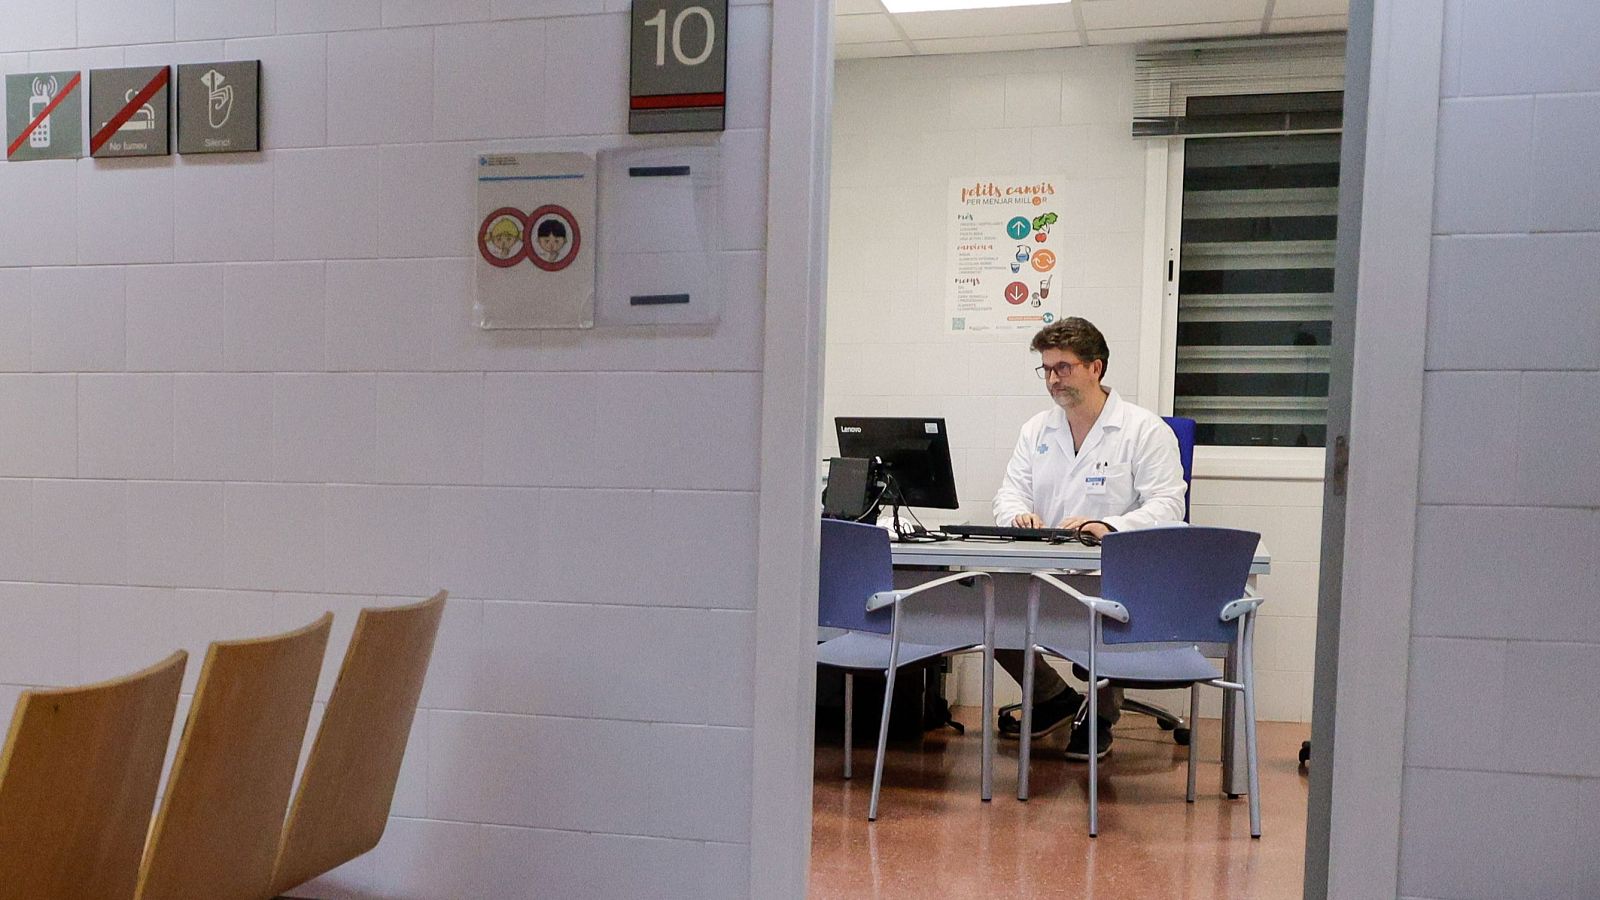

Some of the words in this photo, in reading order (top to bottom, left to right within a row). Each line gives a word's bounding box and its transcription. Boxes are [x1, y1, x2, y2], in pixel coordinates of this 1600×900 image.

[644, 6, 715, 66] 10
[109, 142, 122, 151] No
[961, 183, 1002, 203] petits
[1006, 182, 1055, 196] canvis
[967, 198, 981, 206] PER
[983, 198, 1013, 206] MENJAR
